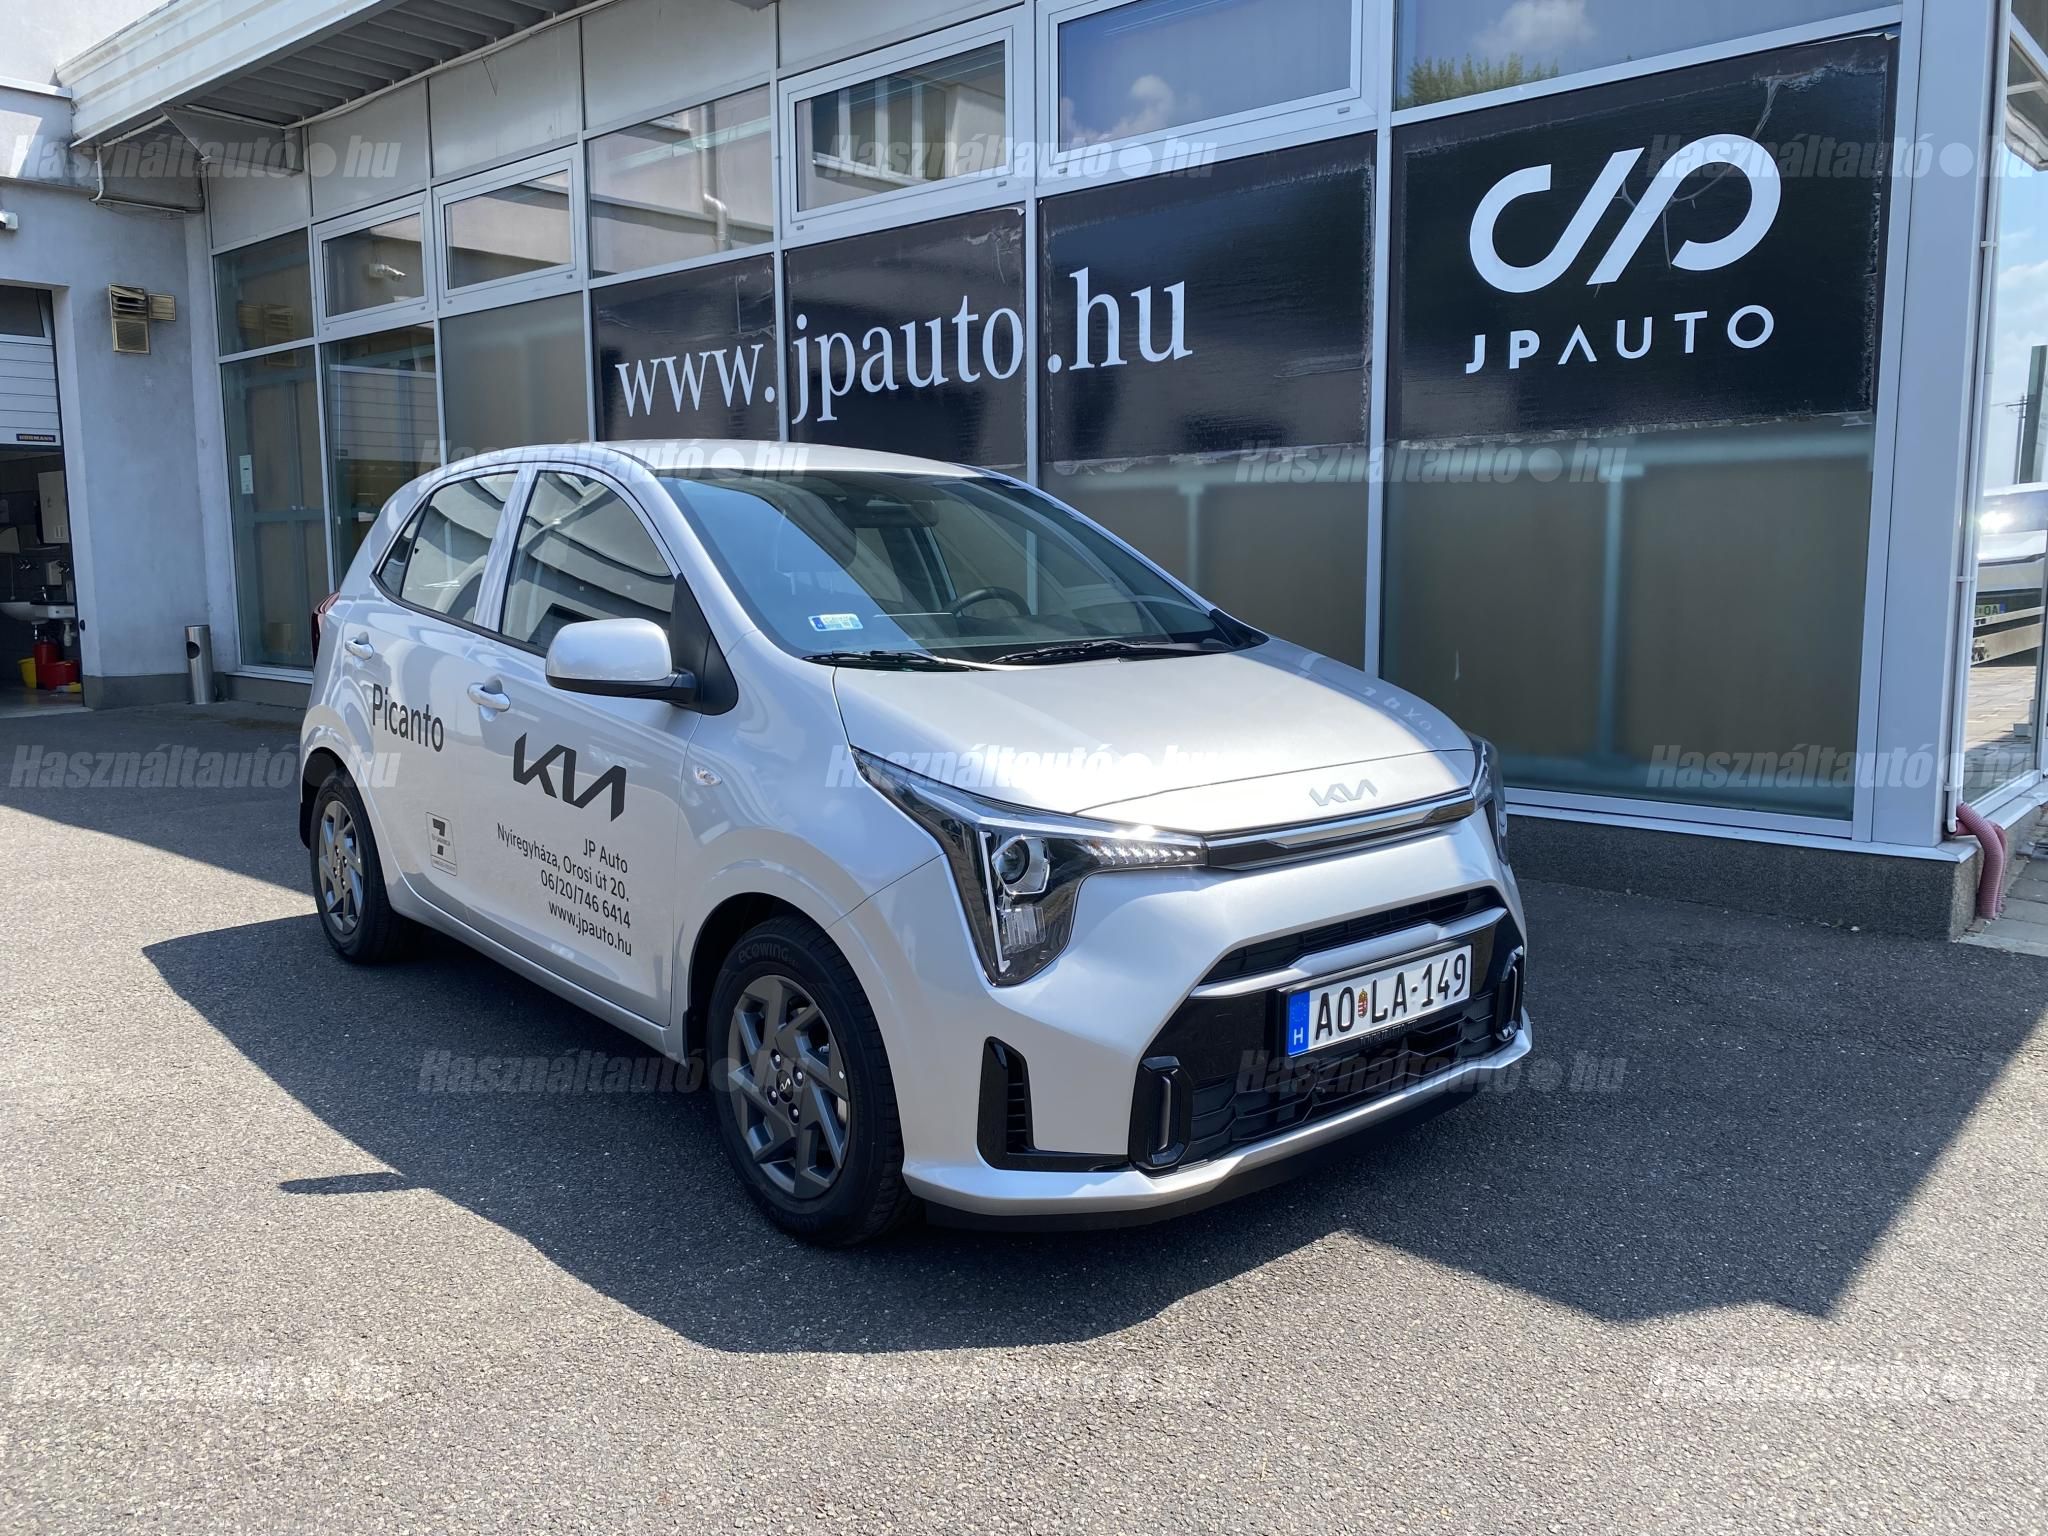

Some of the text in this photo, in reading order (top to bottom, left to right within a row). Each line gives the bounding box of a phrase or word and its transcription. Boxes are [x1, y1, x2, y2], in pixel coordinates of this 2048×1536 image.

[373, 683, 444, 752] Picanto
[513, 732, 626, 822] KIA
[563, 855, 592, 885] Orosi
[595, 871, 607, 891] út
[611, 877, 630, 902] 20.
[583, 838, 628, 874] JP Auto
[541, 869, 631, 929] 06/20/746 6414
[548, 901, 631, 956] www.jpauto.hu
[1316, 986, 1355, 1041] AO
[1371, 953, 1467, 1024] LA-149
[1294, 1027, 1304, 1046] H
